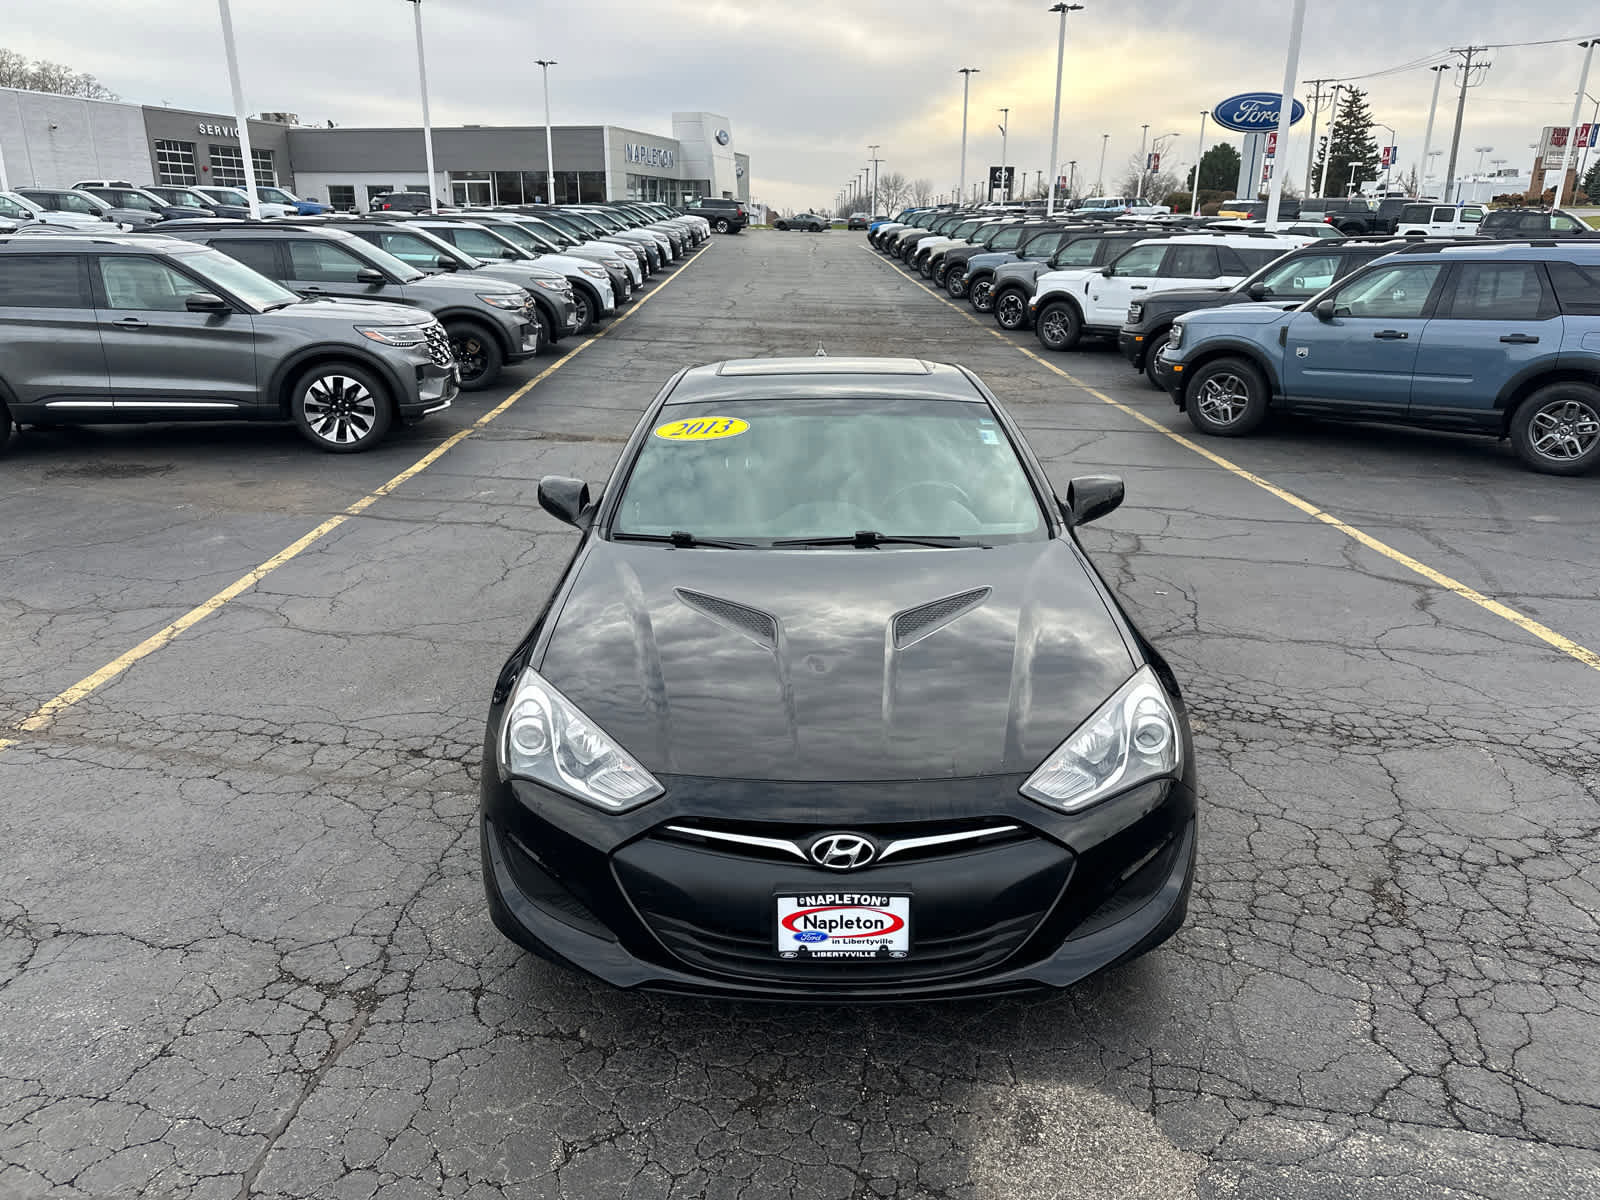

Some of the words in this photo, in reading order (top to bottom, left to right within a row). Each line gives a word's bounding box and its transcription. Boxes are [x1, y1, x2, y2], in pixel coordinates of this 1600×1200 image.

[199, 123, 241, 138] SERVIC
[625, 143, 674, 169] NAPLETON
[670, 419, 735, 437] 2013
[805, 894, 882, 906] NAPLETON
[803, 914, 884, 933] Napleton
[800, 932, 822, 942] Ford
[843, 938, 894, 946] Libertyville
